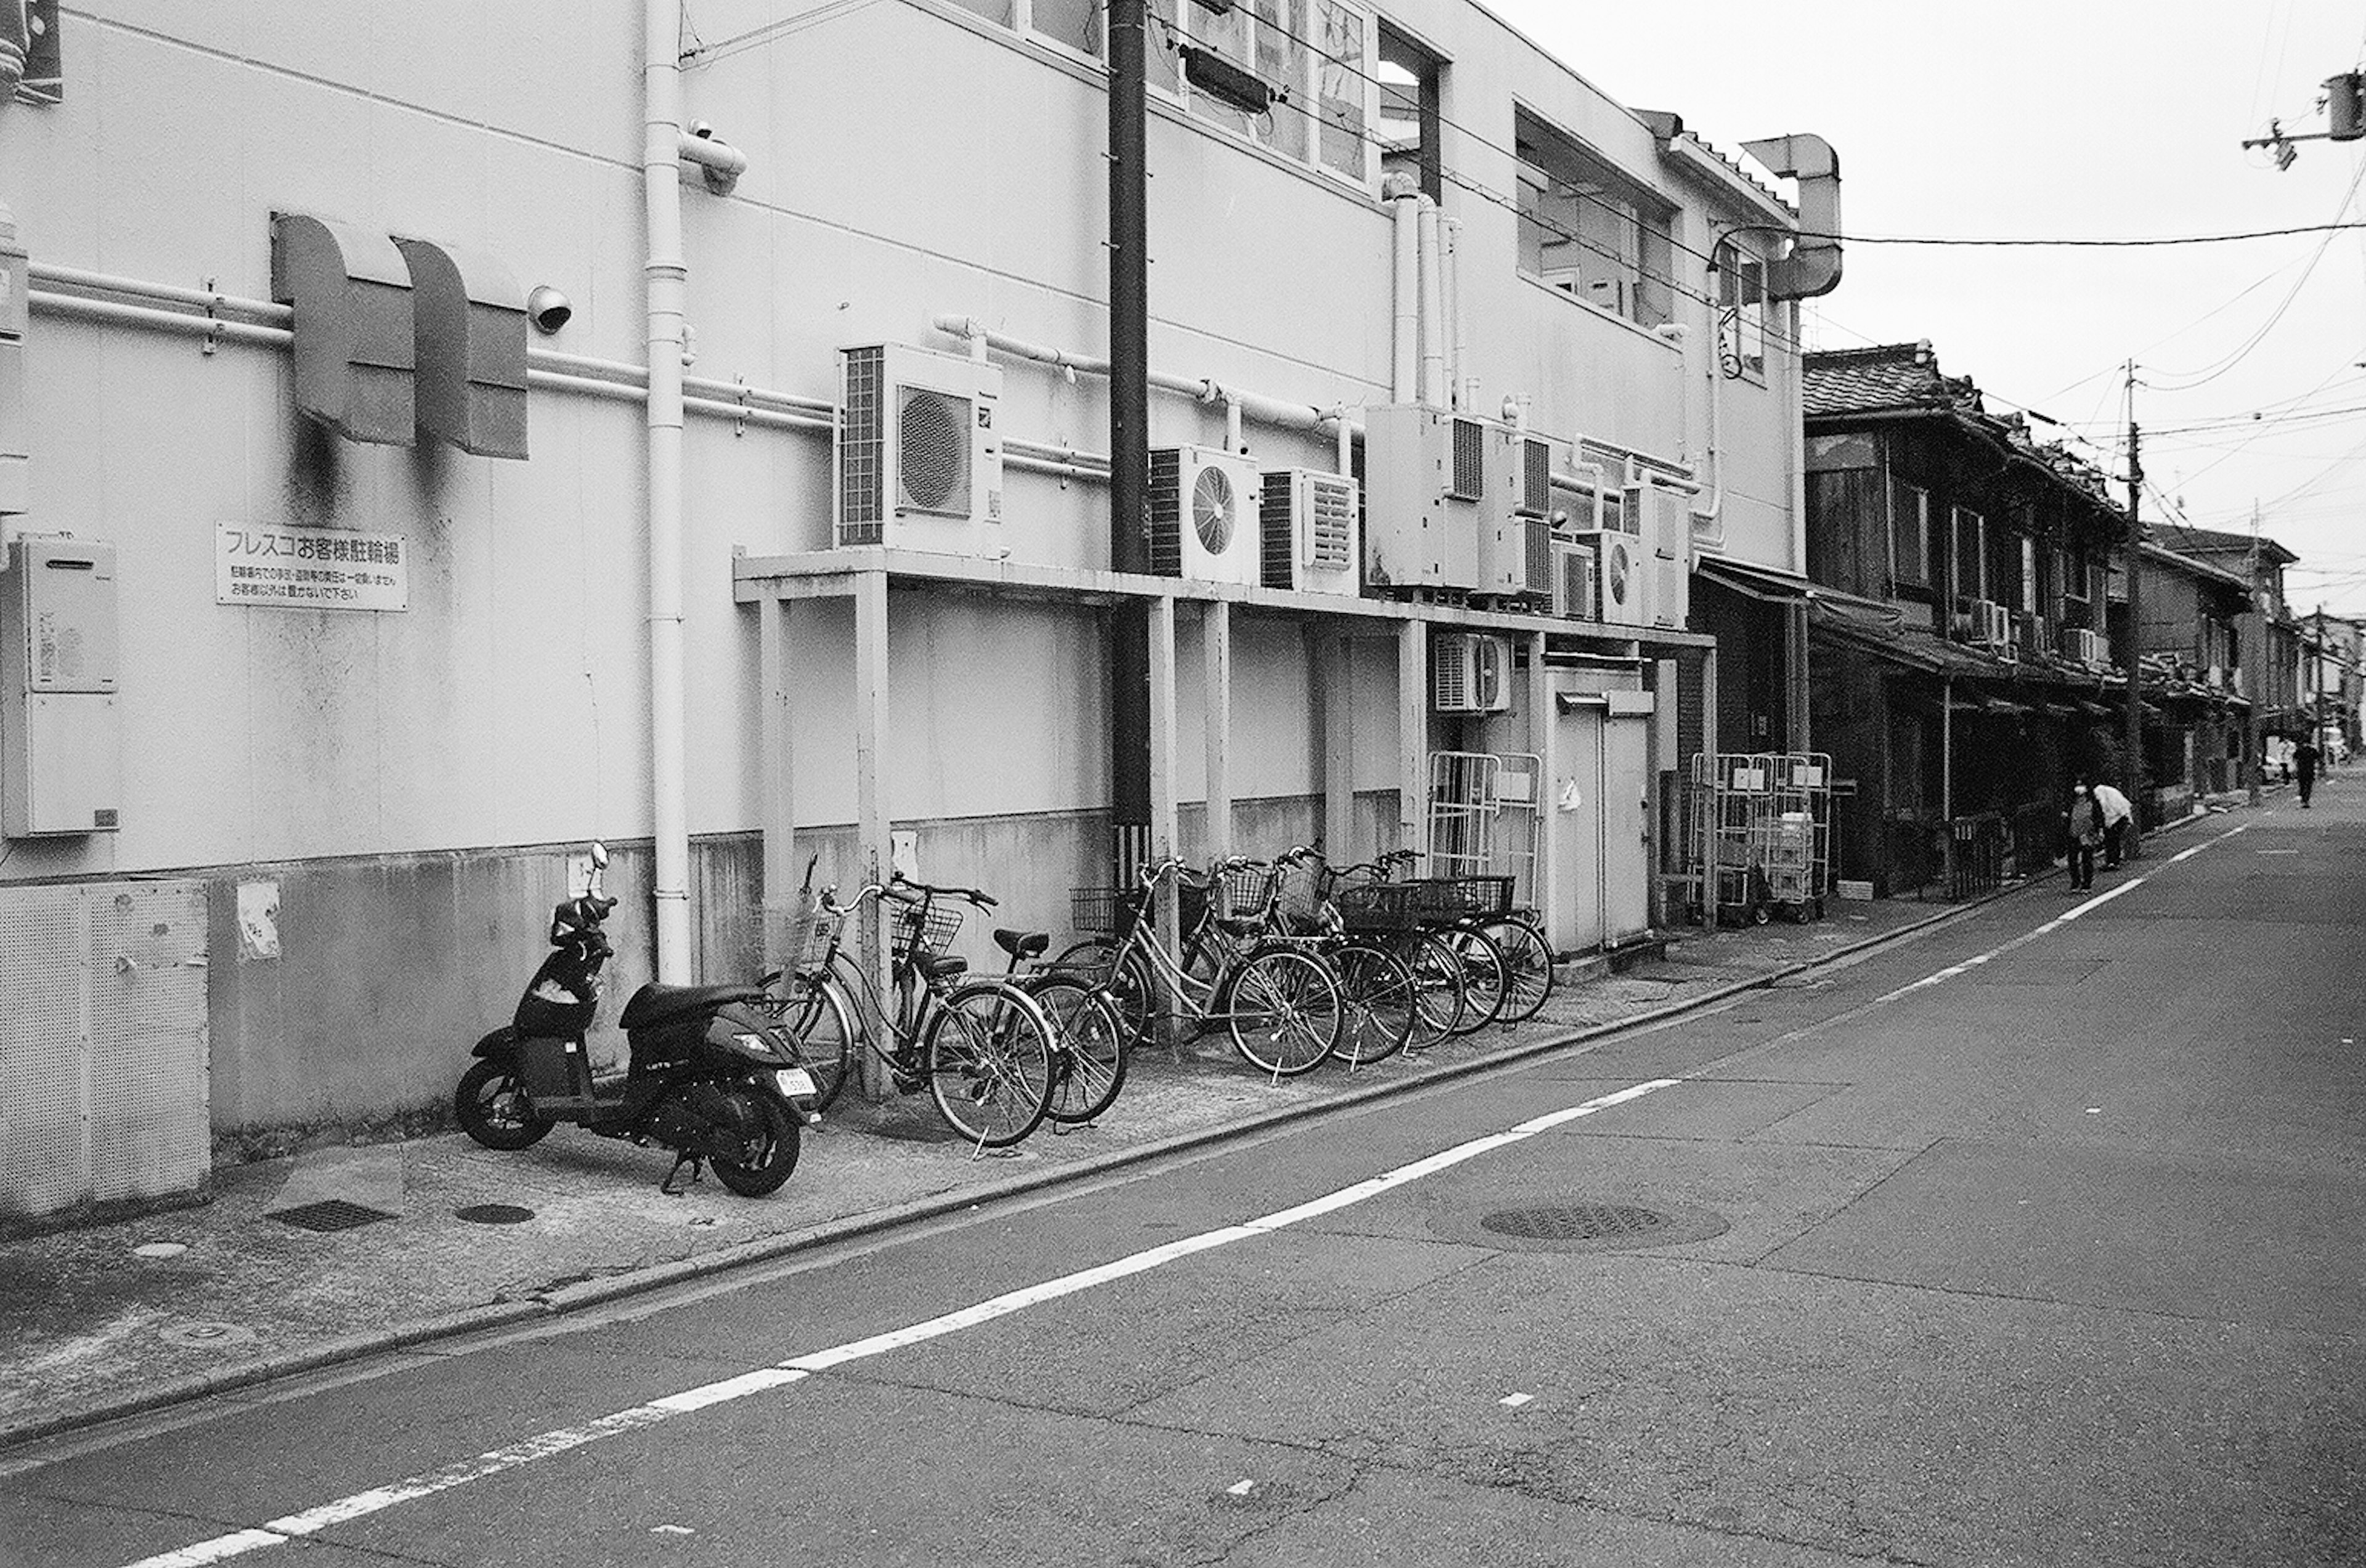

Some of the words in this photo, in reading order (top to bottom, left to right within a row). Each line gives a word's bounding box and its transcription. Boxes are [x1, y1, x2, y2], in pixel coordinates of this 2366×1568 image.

[226, 531, 399, 564] フレスコお客様駐輪場
